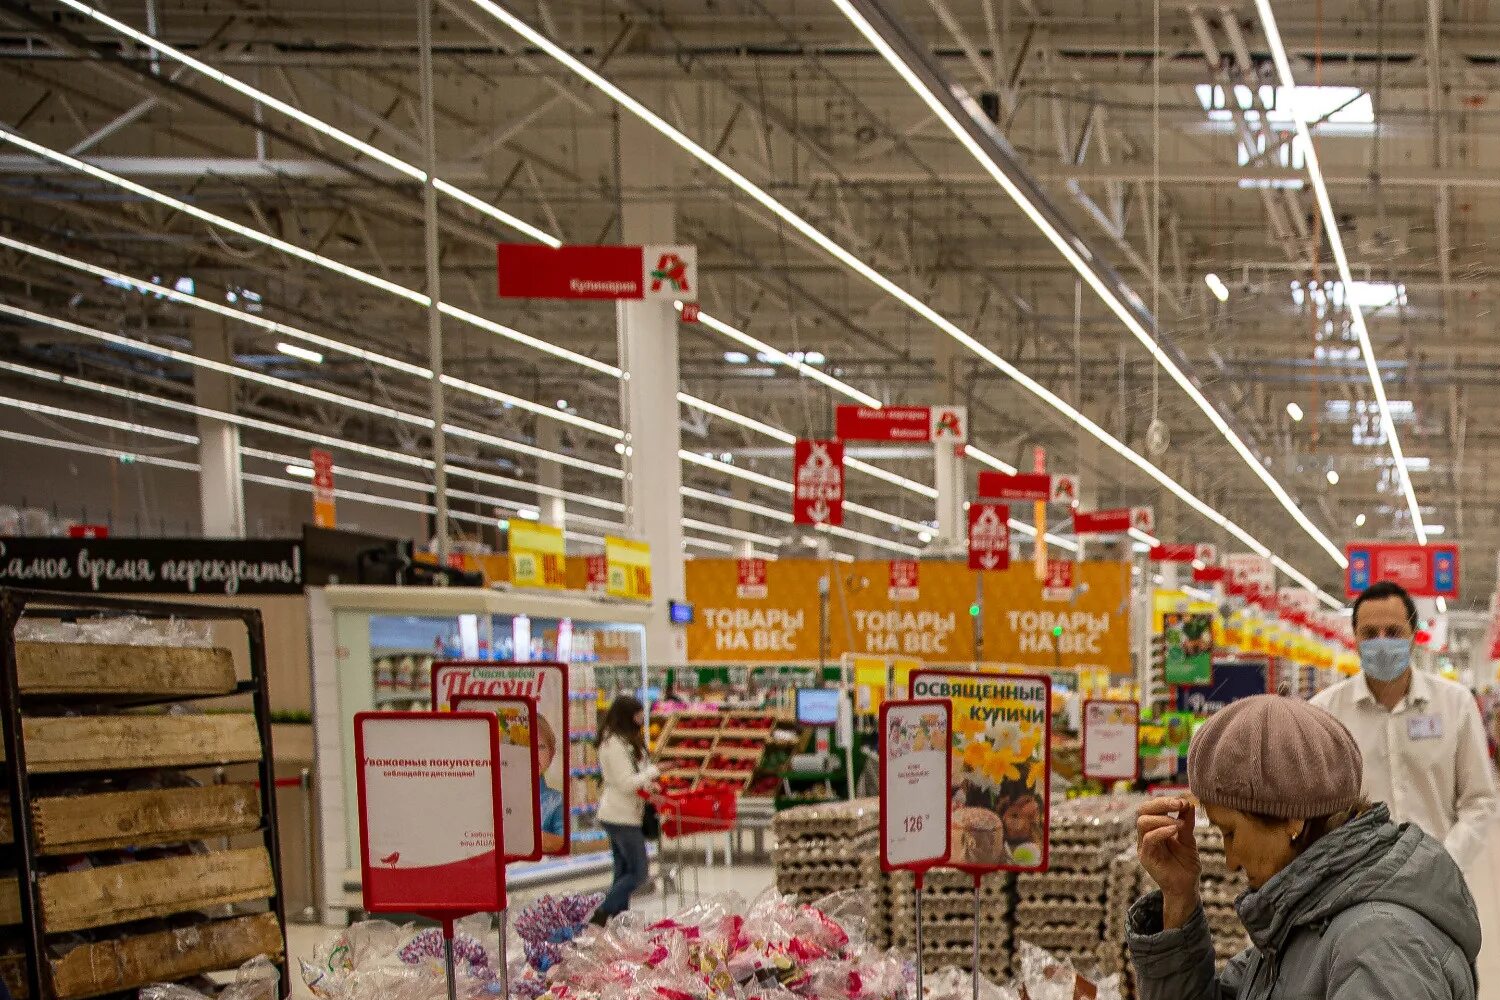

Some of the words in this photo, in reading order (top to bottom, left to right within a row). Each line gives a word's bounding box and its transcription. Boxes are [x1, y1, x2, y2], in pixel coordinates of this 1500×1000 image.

[77, 548, 155, 591] время
[160, 544, 302, 596] перекусить!
[703, 607, 805, 630] ТОВАРЫ
[852, 608, 956, 632] ТОВАРЫ
[1006, 610, 1110, 633] ТОВАРЫ
[715, 629, 750, 651] НА
[752, 629, 798, 652] ВЕС
[865, 631, 900, 653] НА
[903, 631, 948, 653] ВЕС
[1019, 632, 1056, 653] НА
[1058, 632, 1102, 653] ВЕС
[915, 681, 1045, 702] ОСВЯЩЕННЫЕ
[970, 705, 1045, 724] КУЛИЧИ
[904, 815, 923, 832] 126
